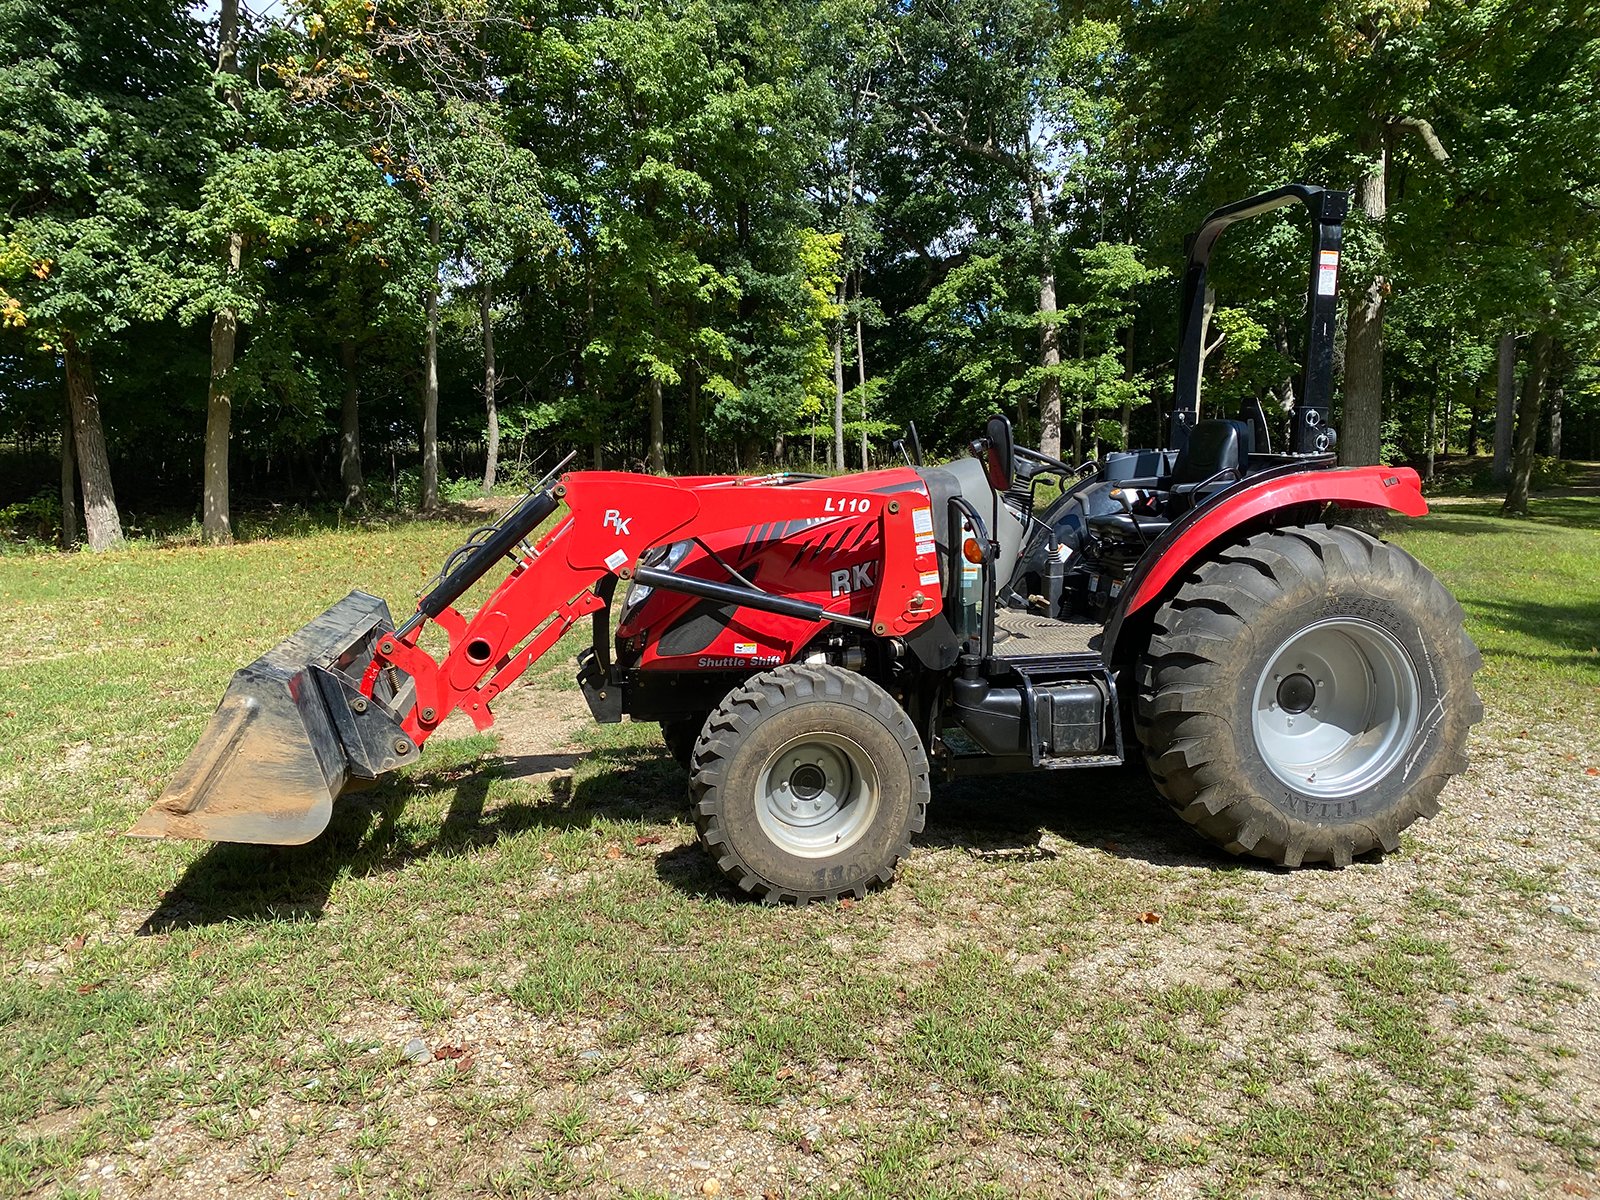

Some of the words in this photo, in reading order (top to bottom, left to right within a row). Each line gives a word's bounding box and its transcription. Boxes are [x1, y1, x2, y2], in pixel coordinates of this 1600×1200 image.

[824, 497, 871, 513] L110
[603, 509, 633, 536] RK
[831, 560, 879, 597] RK
[698, 657, 746, 667] Shuttle
[750, 655, 781, 666] Shift
[1280, 791, 1362, 819] TITAN
